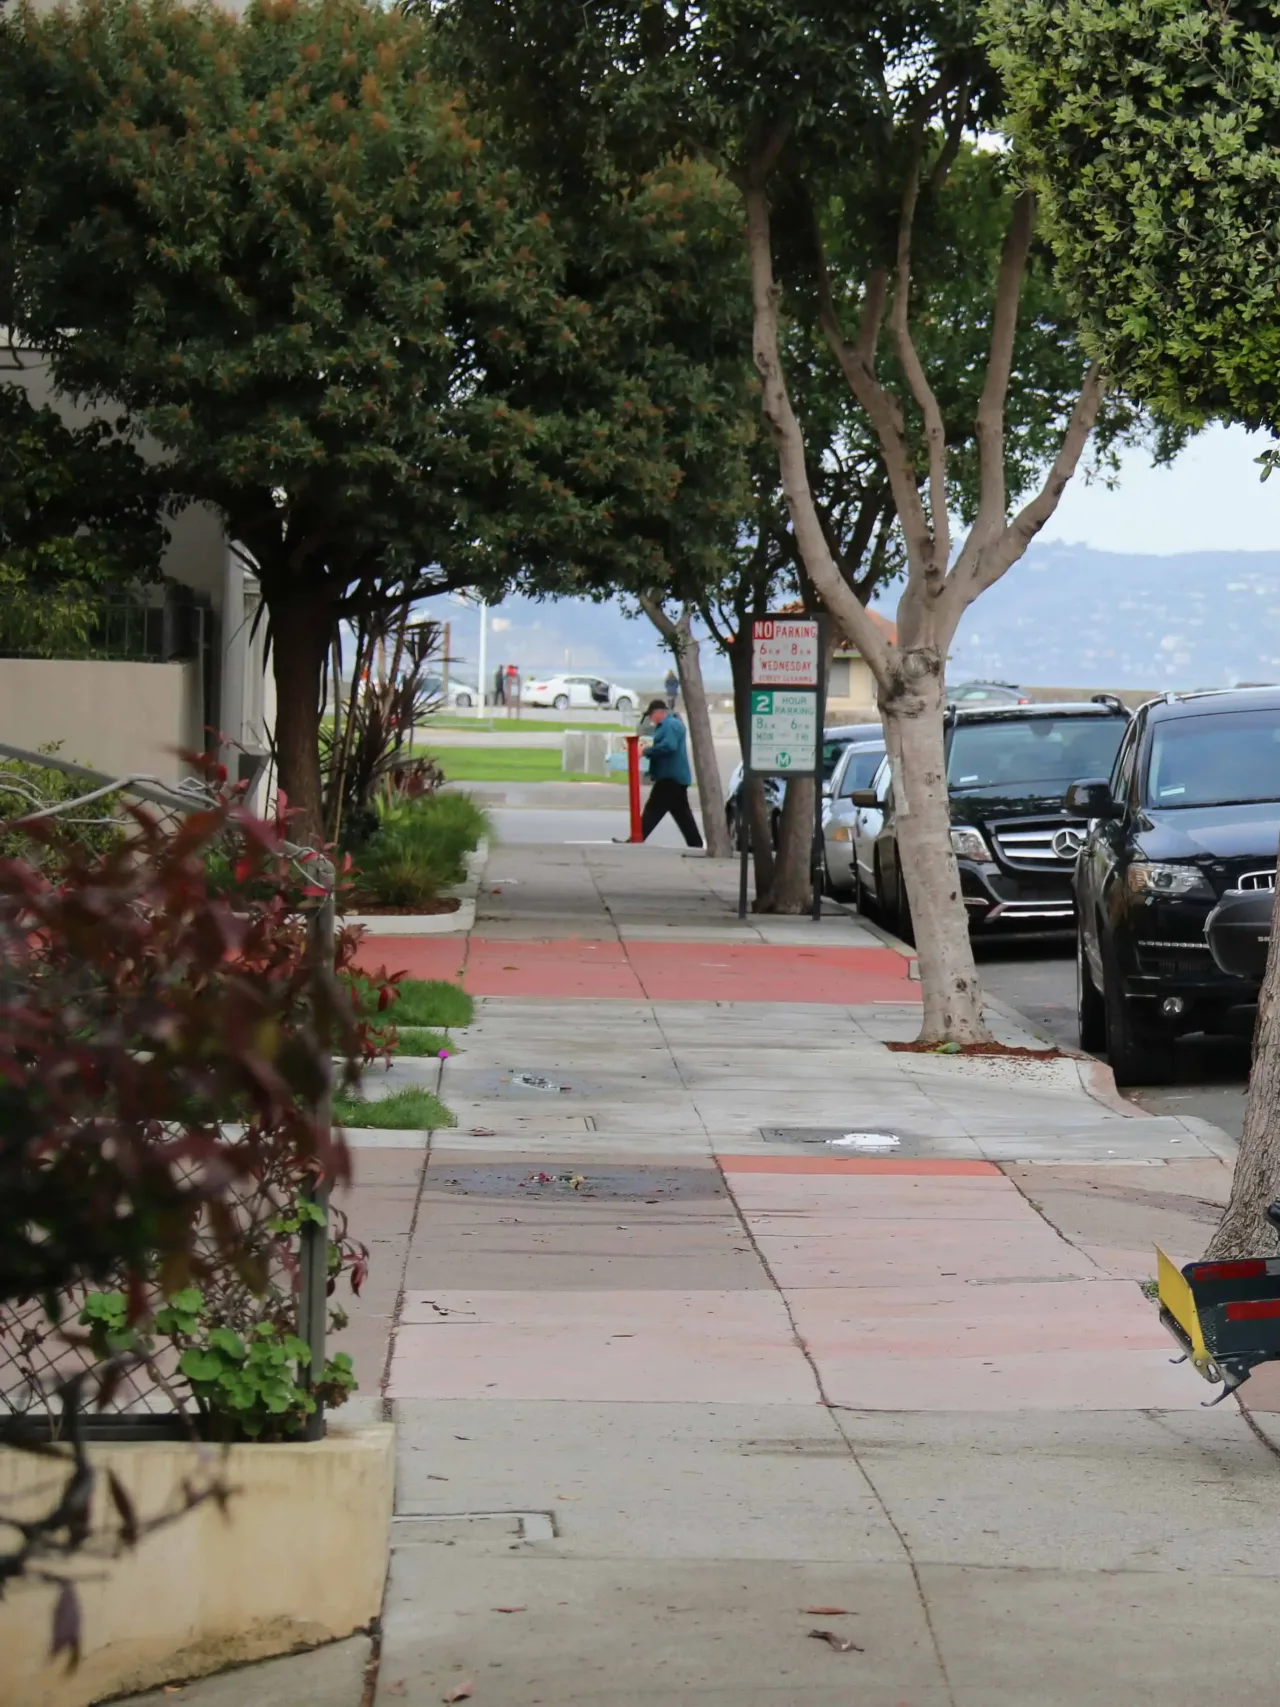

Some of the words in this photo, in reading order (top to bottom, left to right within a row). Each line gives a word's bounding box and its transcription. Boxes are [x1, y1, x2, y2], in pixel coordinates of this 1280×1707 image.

[754, 621, 773, 638] NO
[775, 625, 817, 638] PARKING
[761, 661, 811, 671] WEDNESDAY
[756, 695, 770, 712] 2
[781, 696, 807, 705] HOUR
[775, 706, 814, 716] PARKING
